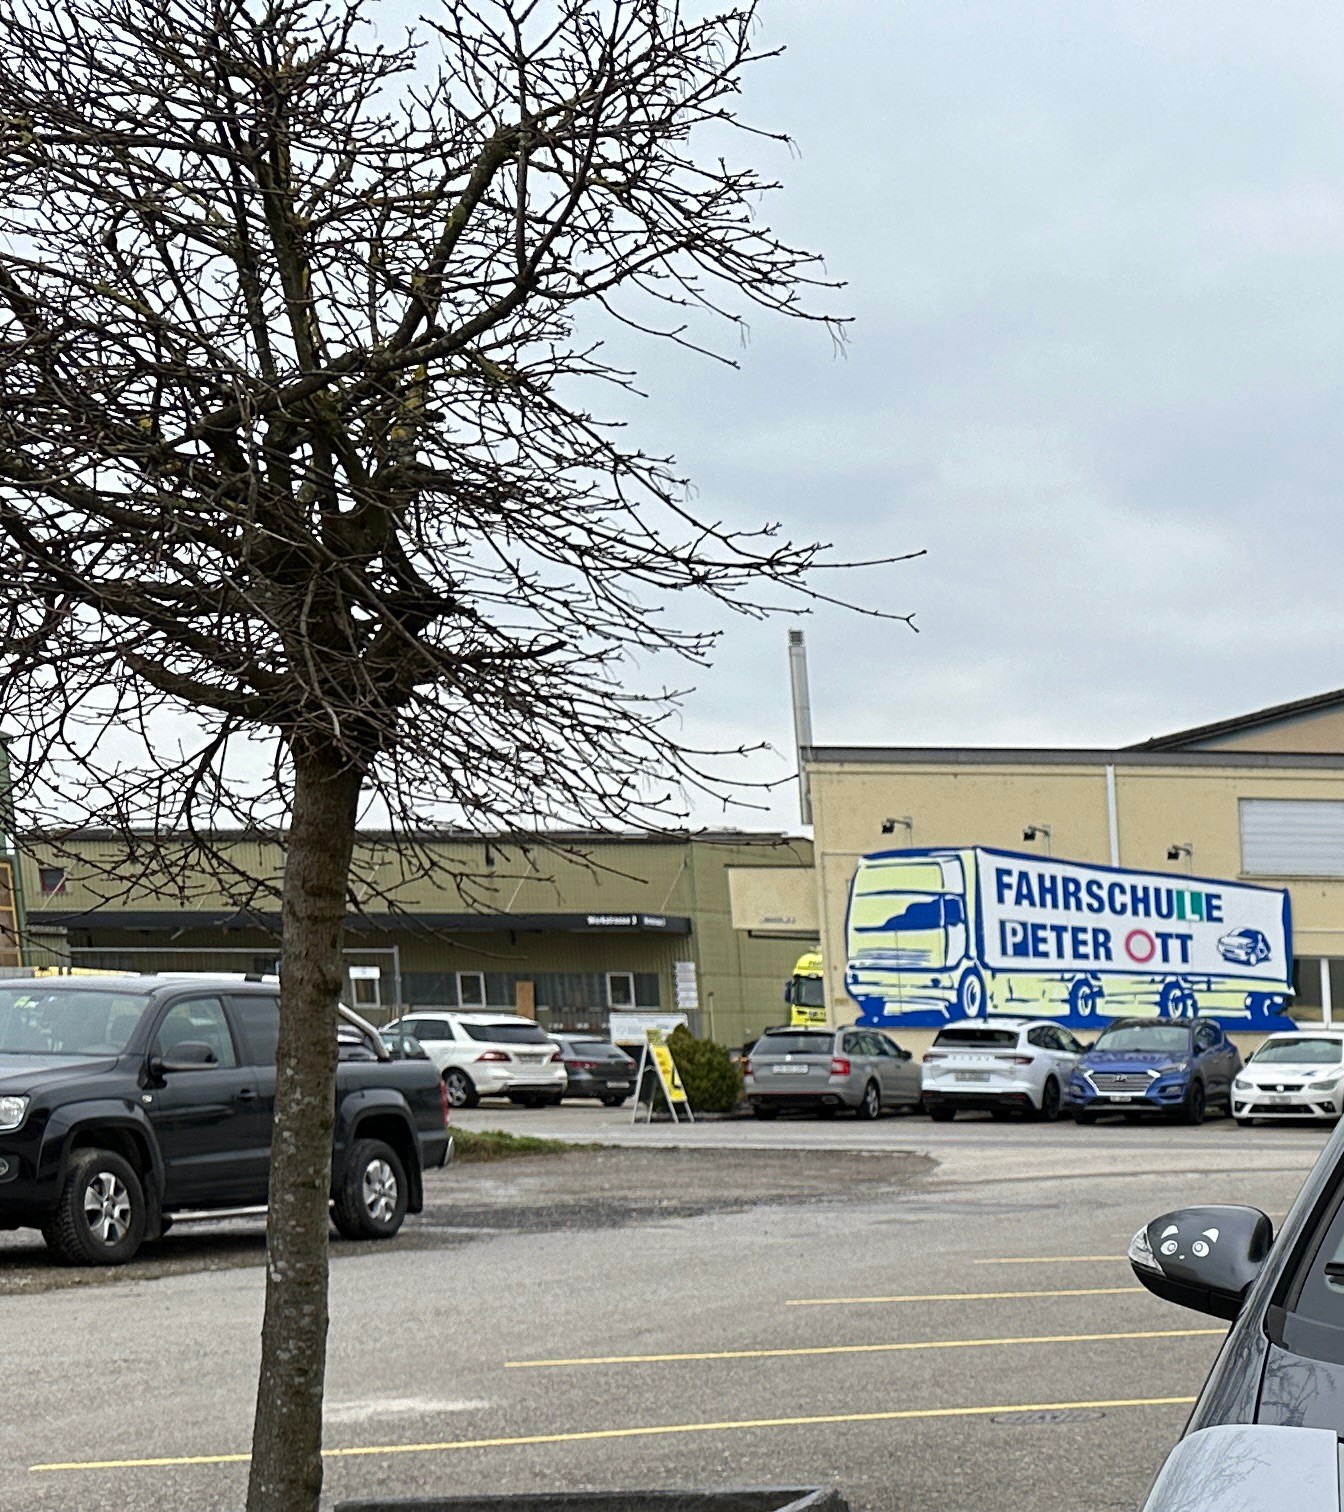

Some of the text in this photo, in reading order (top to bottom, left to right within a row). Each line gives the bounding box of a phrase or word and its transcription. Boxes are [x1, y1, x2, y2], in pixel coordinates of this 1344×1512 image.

[995, 867, 1224, 924] FAHRSCHULE
[999, 918, 1194, 965] PETER OTT
